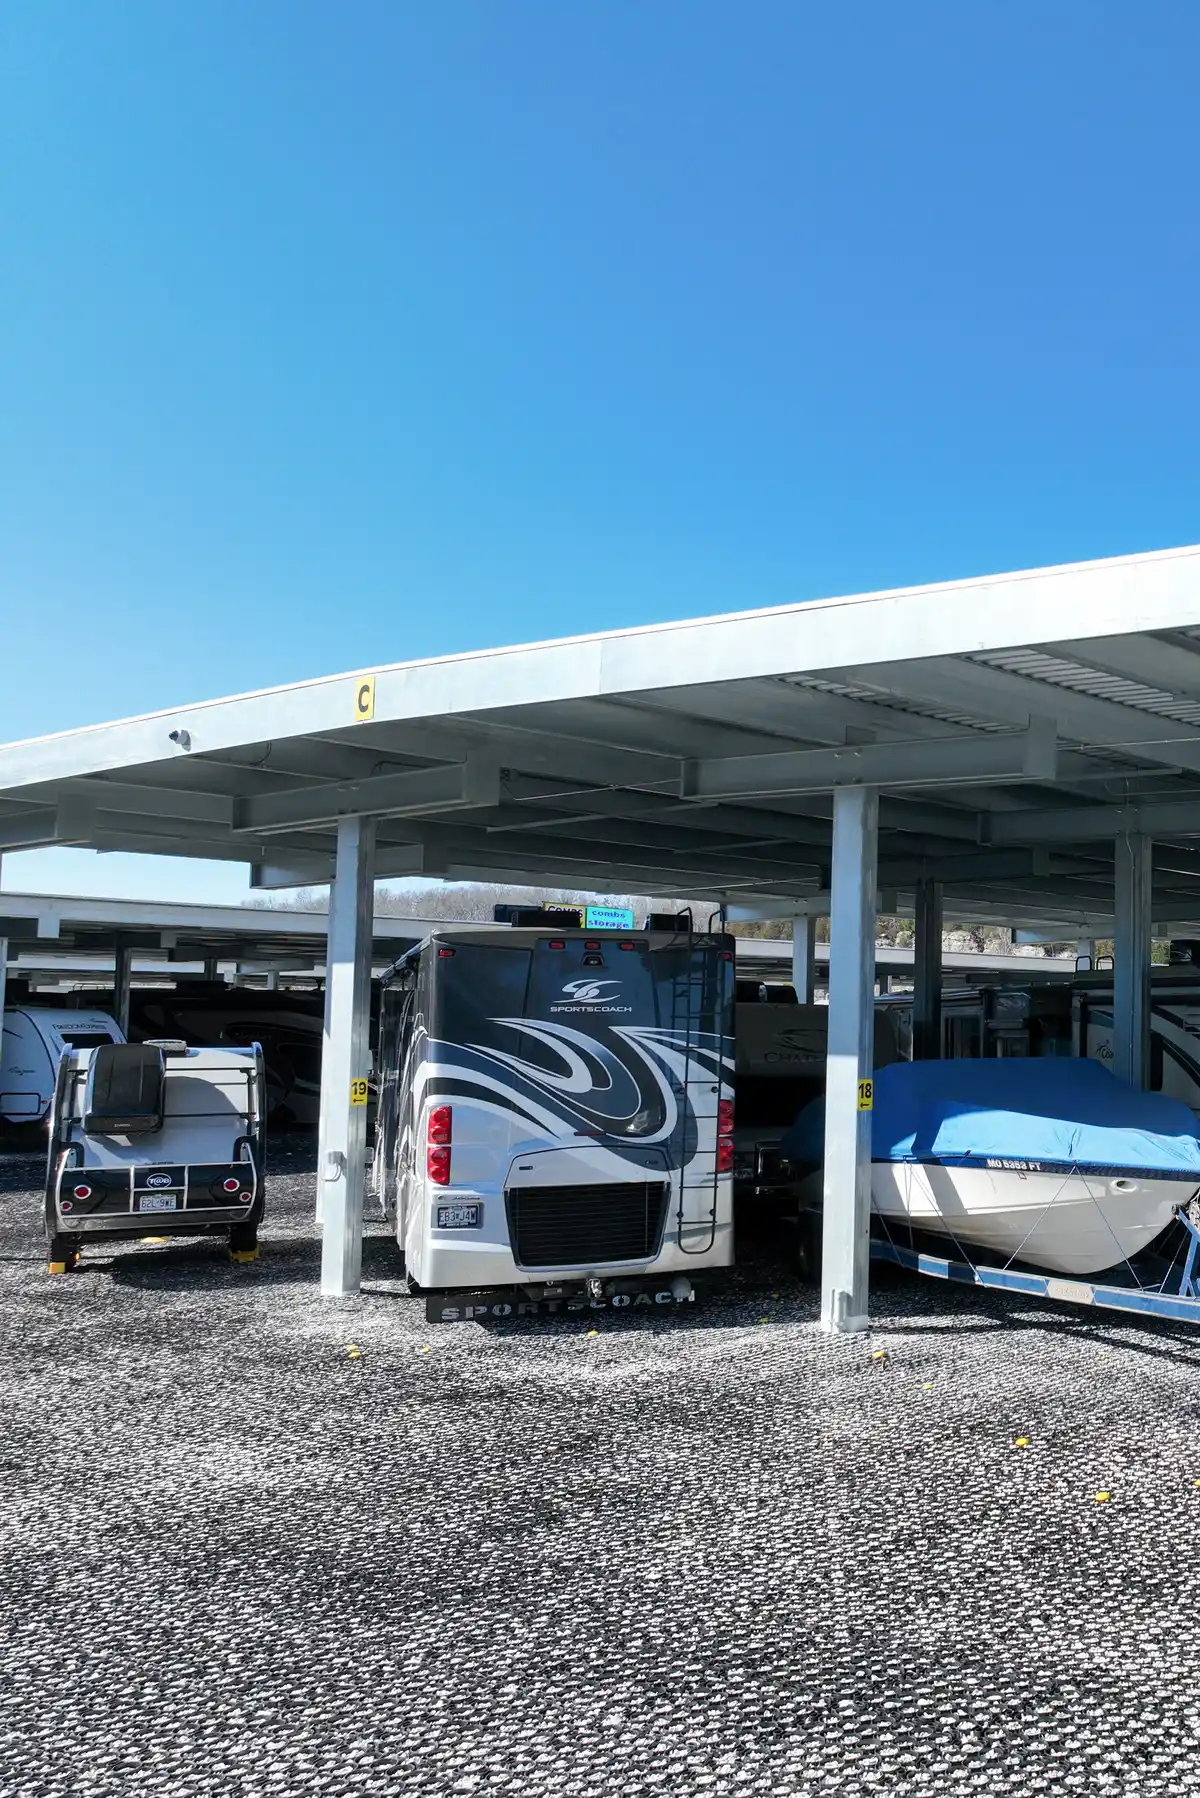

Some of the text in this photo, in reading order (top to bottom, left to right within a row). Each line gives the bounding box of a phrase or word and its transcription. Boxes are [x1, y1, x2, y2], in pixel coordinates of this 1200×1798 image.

[358, 684, 370, 713] C
[591, 909, 626, 919] combs
[351, 1081, 367, 1096] 19
[858, 1082, 872, 1099] 18
[149, 1176, 170, 1186] T@B
